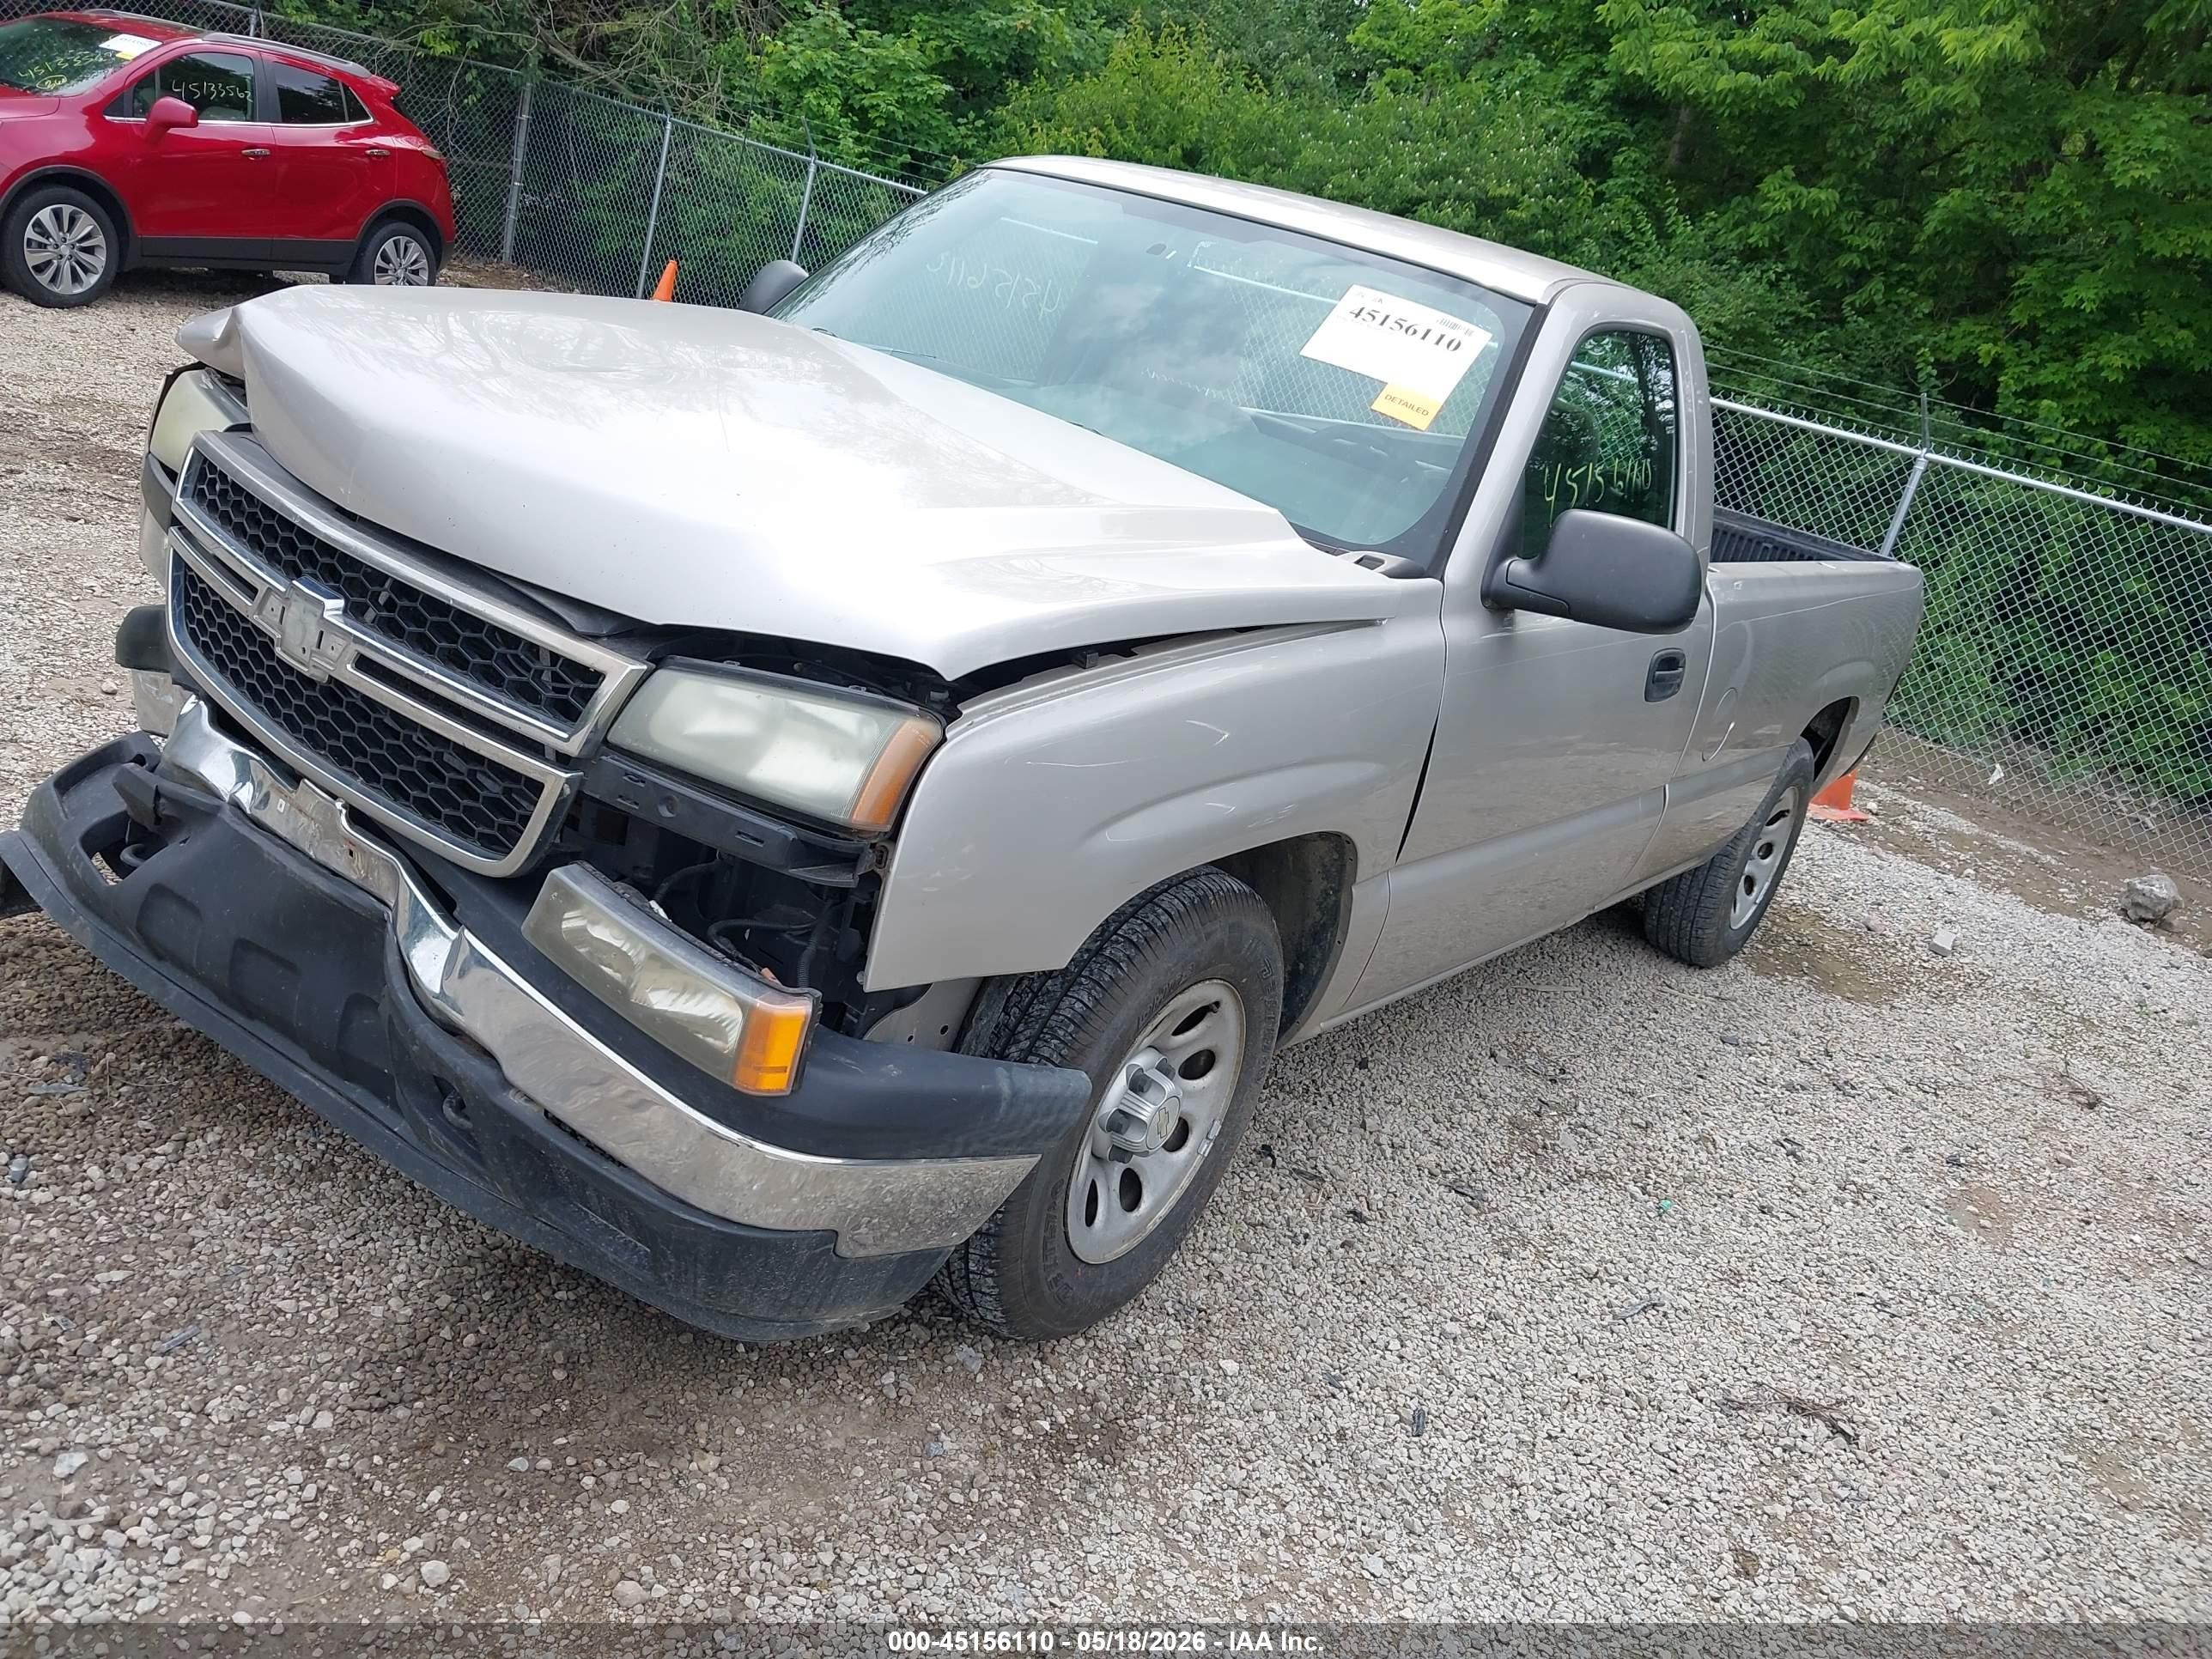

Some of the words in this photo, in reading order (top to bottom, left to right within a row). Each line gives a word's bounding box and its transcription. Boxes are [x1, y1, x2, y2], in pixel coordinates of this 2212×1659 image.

[172, 79, 253, 102] 45133562
[1348, 306, 1462, 353] 45156110
[1384, 392, 1430, 417] DETAILED
